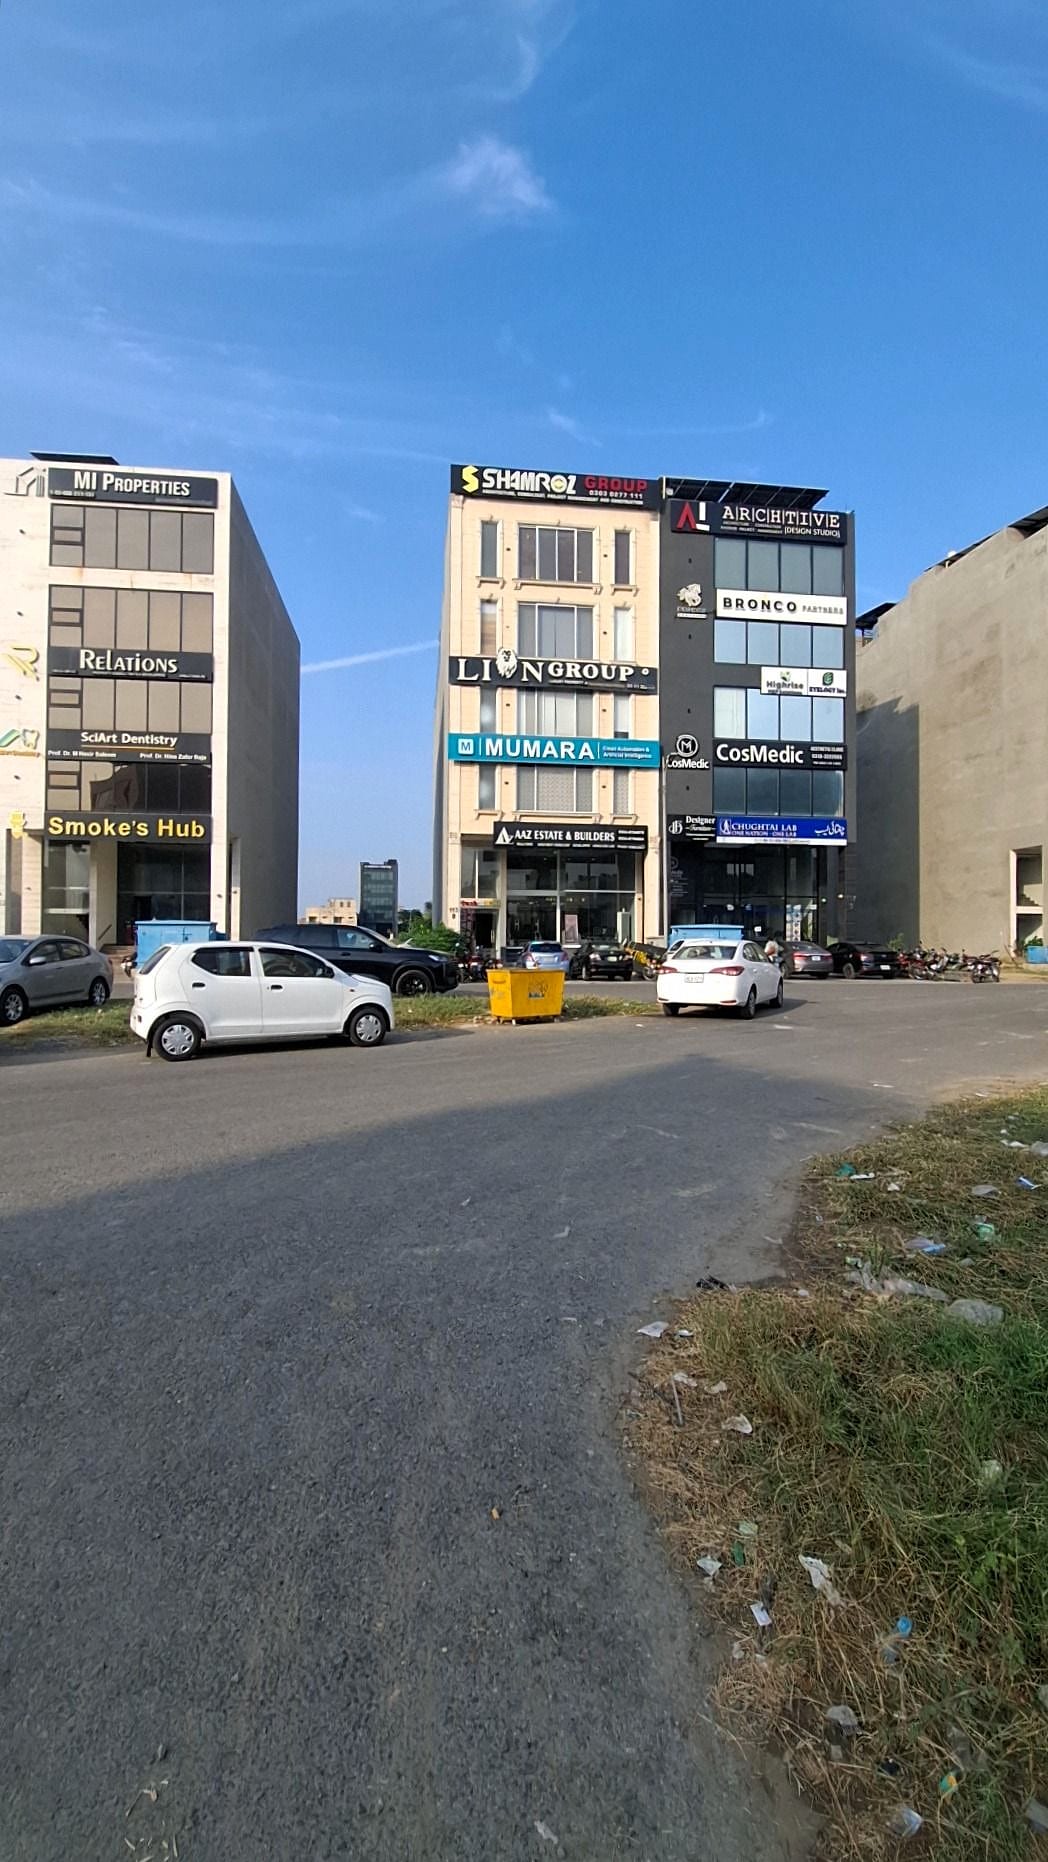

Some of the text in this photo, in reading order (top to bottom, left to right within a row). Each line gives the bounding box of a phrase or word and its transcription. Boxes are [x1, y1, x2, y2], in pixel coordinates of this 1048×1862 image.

[74, 471, 97, 491] MI
[102, 472, 191, 497] PROPERTIES
[584, 475, 648, 492] GROUP
[722, 597, 797, 613] BRONCO
[547, 662, 635, 681] GROUP
[80, 731, 178, 747] SciArt Dentistry
[485, 738, 595, 760] MUMARA
[716, 743, 804, 764] CosMedic
[48, 816, 205, 838] Smoke's Hub
[686, 816, 716, 825] Designer
[731, 822, 798, 832] CHUGHTAI LAB
[515, 830, 532, 840] AAZ
[534, 830, 563, 841] ESTATE
[574, 832, 615, 841] BUILDERS
